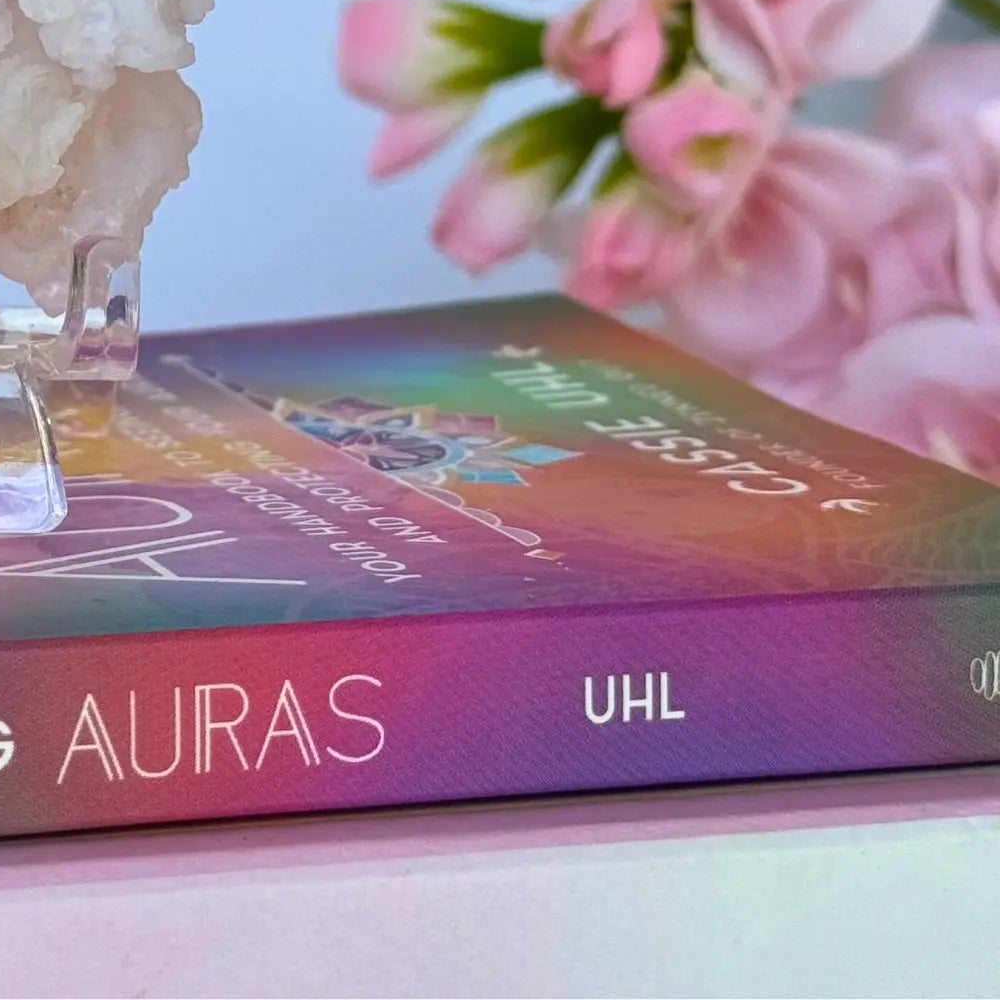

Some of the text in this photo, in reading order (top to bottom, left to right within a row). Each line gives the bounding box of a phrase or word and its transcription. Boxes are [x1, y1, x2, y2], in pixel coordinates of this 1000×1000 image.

[490, 361, 810, 494] CASSIE UHL
[206, 470, 348, 536] HANDBOOK
[223, 440, 385, 512] PROTECTING
[329, 541, 423, 584] YOUR
[368, 516, 448, 544] AND
[58, 674, 387, 785] AURAS
[584, 671, 686, 725] UHL
